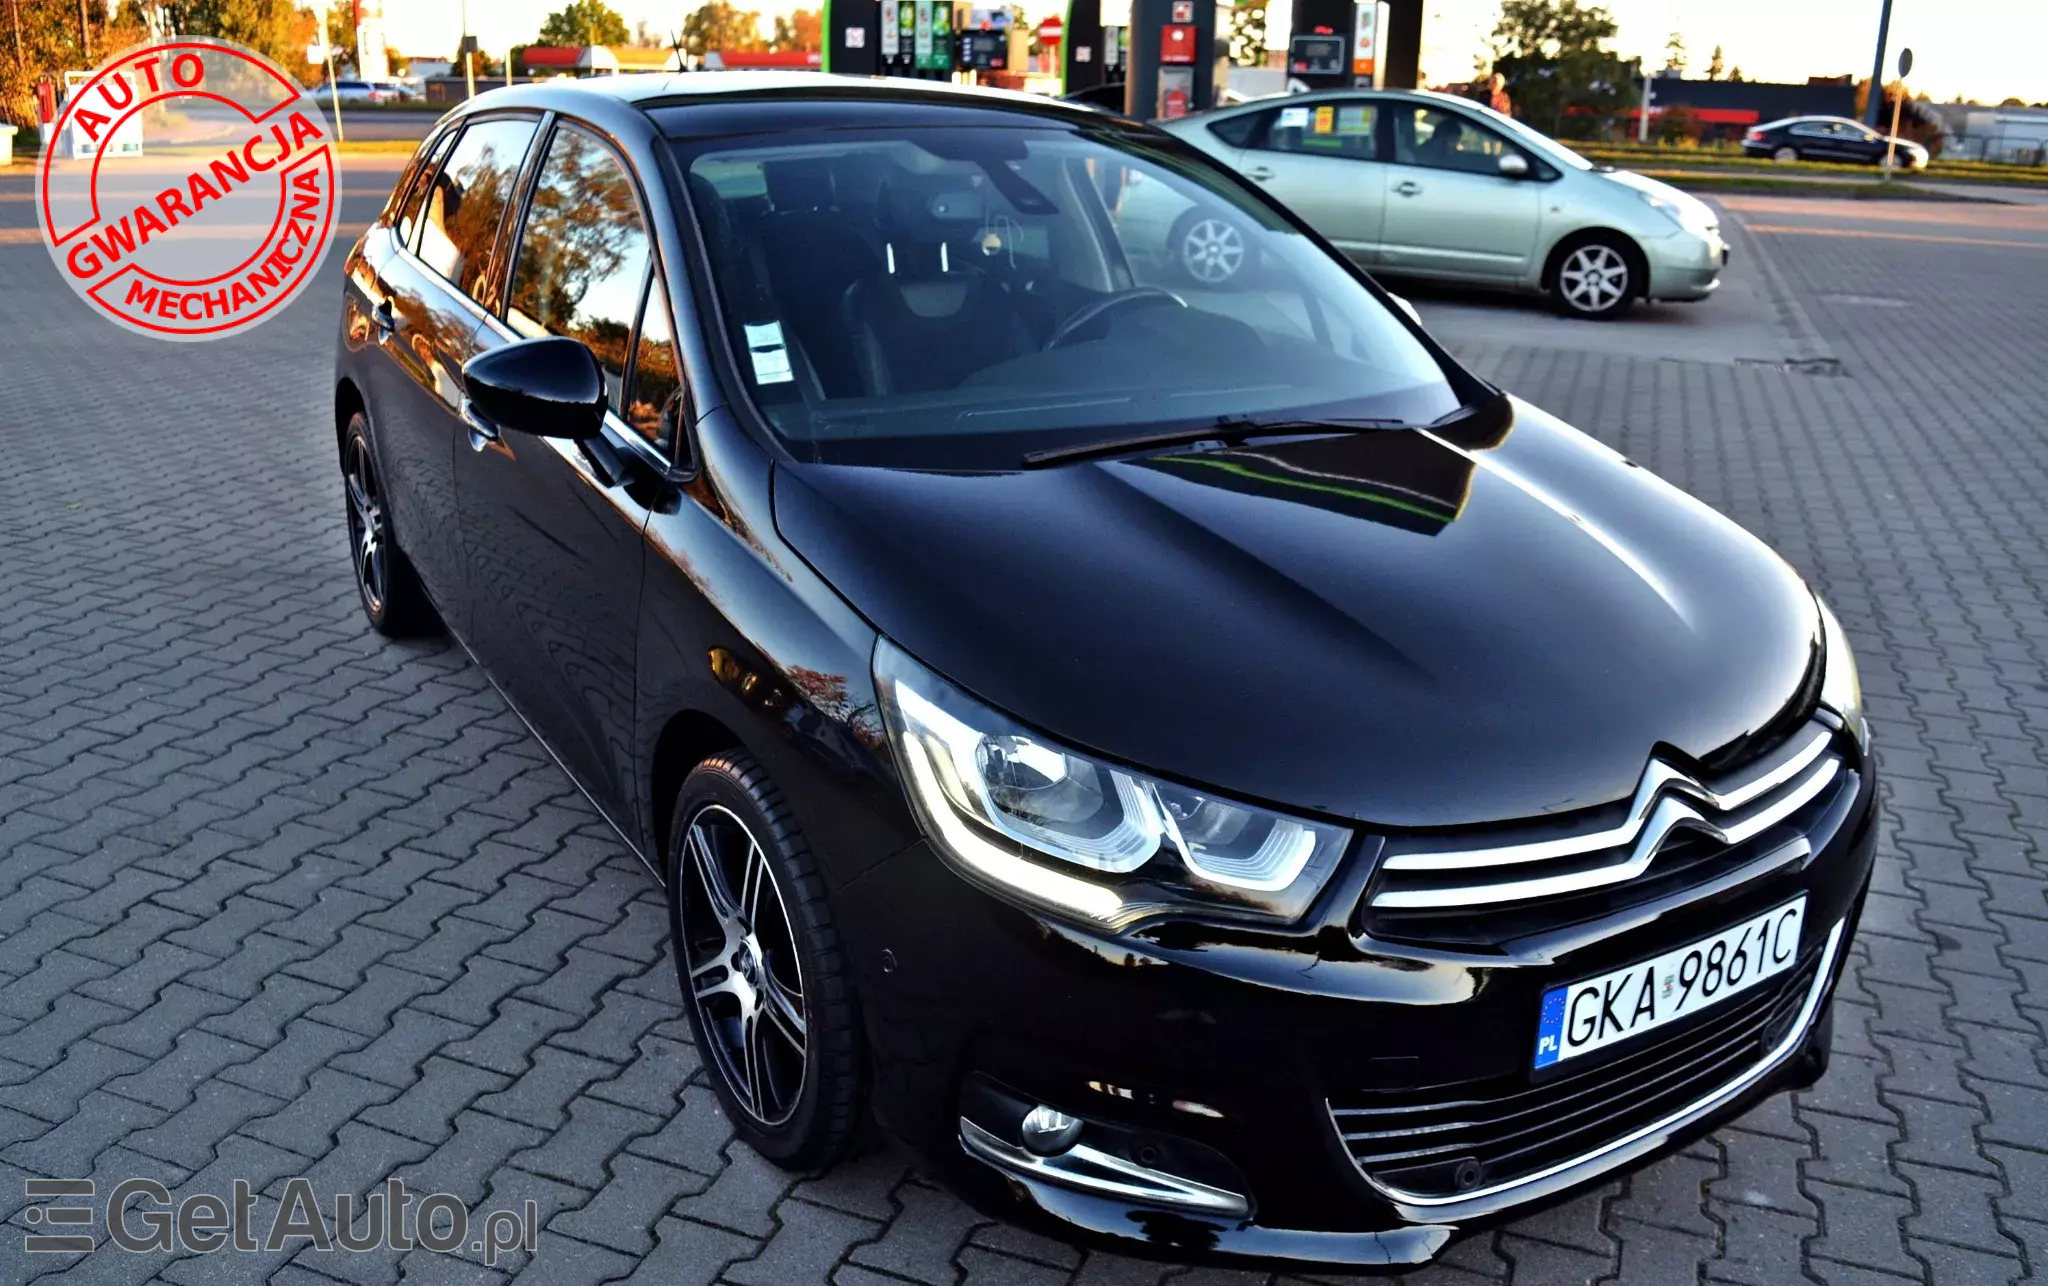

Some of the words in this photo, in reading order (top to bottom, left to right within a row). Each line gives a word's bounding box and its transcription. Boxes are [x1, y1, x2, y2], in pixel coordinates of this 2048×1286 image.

[1567, 966, 1655, 1047] GKA
[1675, 908, 1797, 1011] 9861C
[1538, 1036, 1558, 1055] PL
